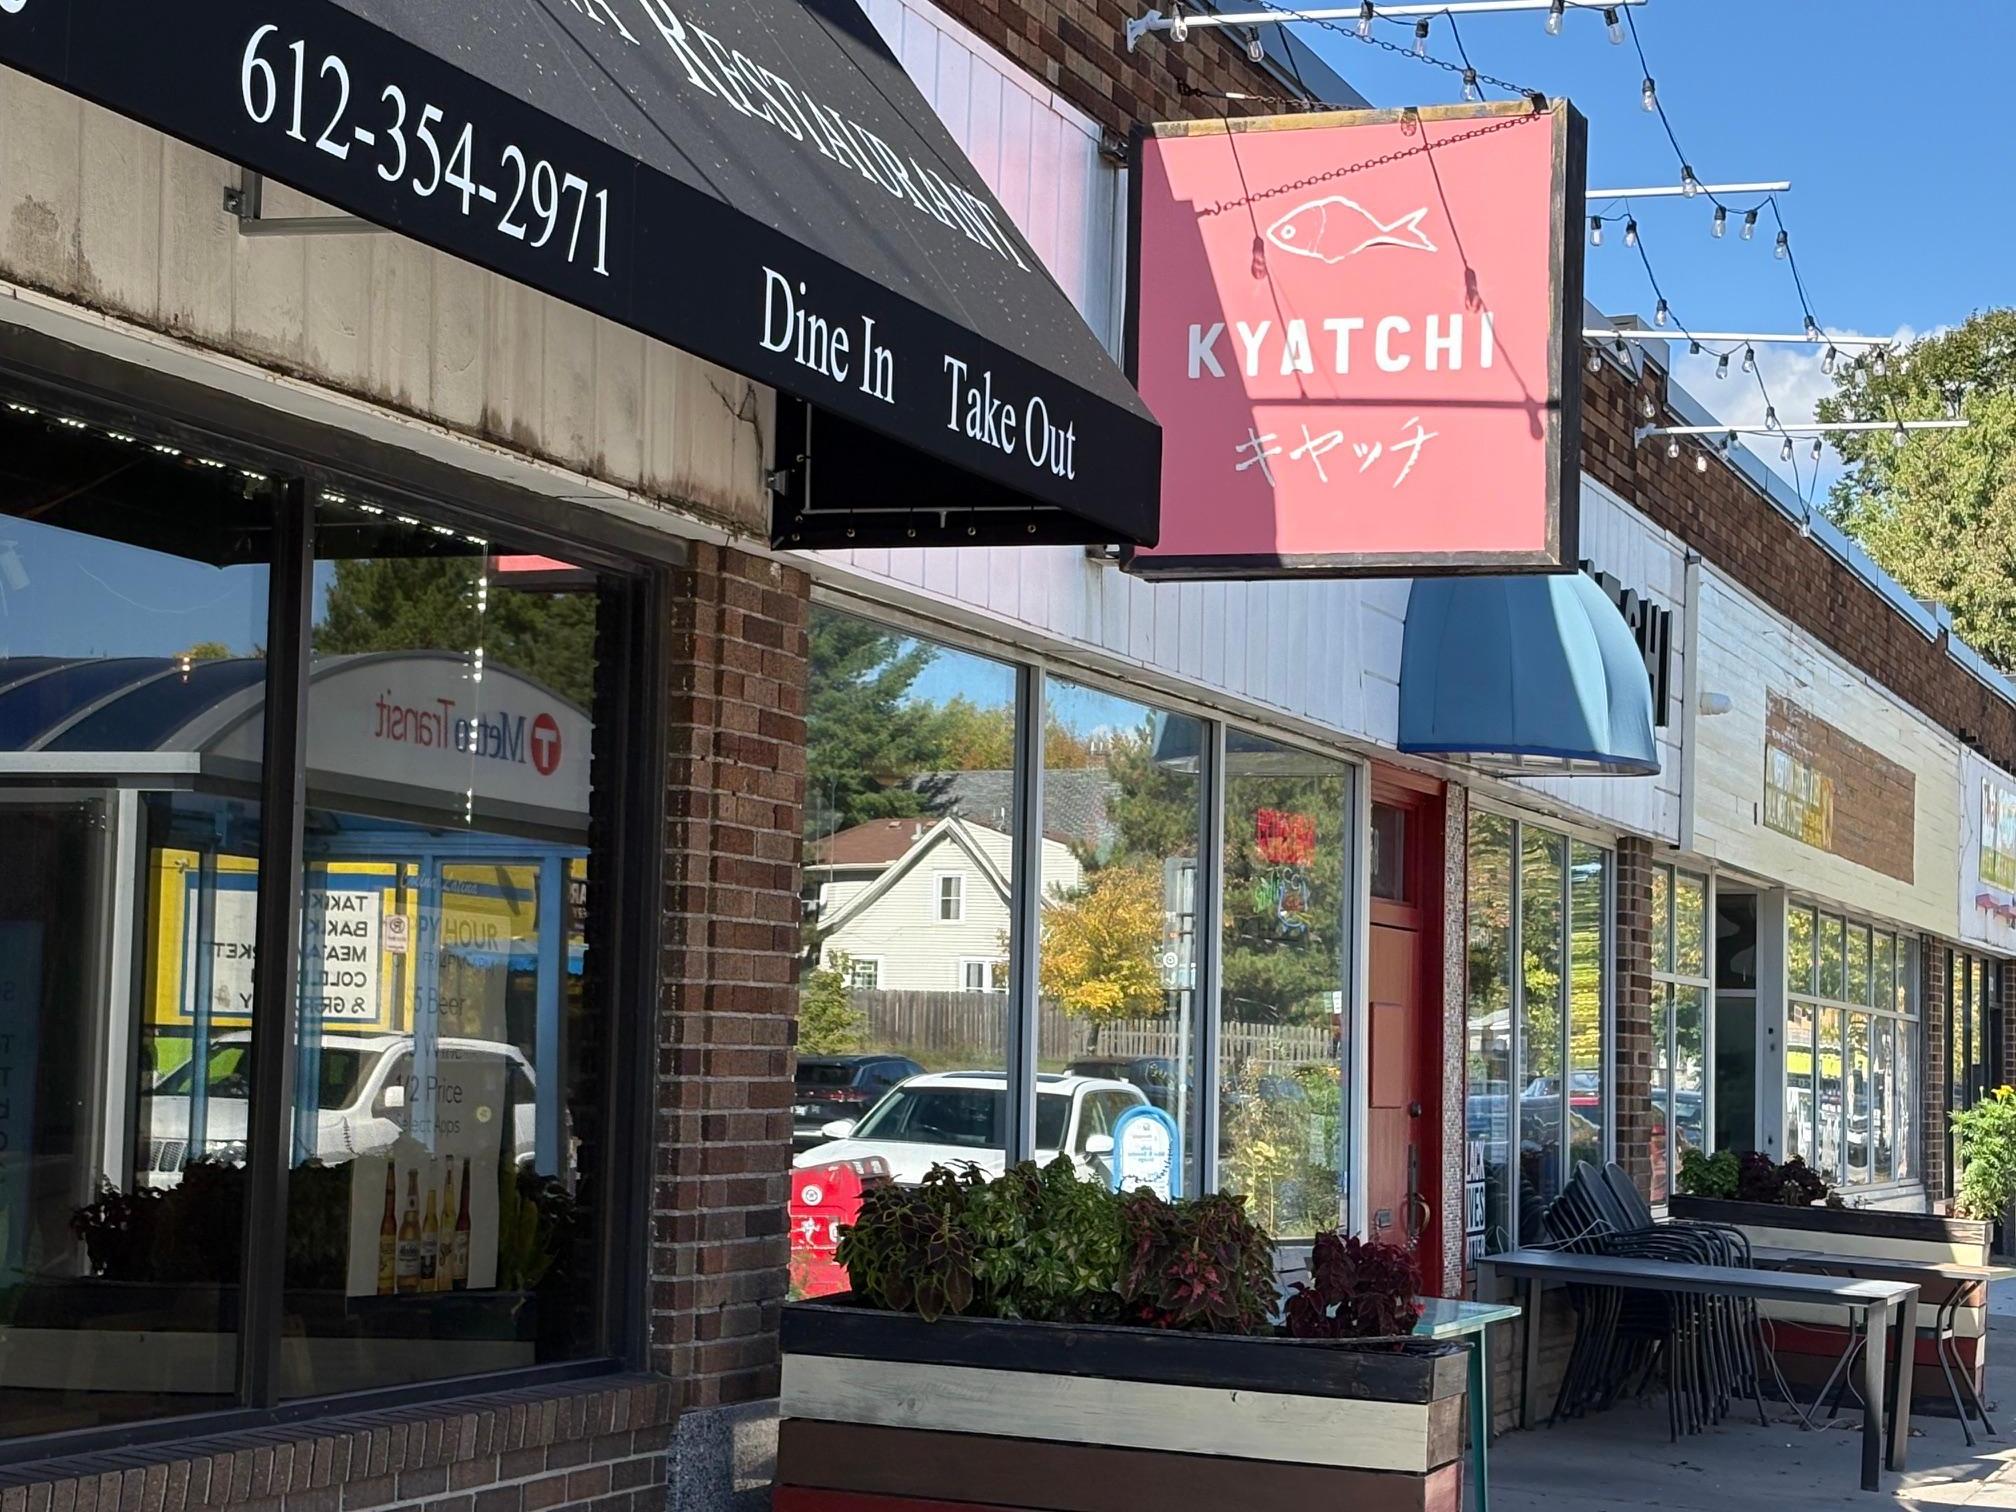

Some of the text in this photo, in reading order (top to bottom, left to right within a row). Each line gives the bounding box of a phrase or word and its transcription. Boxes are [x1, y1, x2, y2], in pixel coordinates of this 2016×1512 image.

[241, 23, 610, 277] 612-354-2971
[760, 266, 895, 404] Dine In
[1188, 312, 1494, 379] KYATCHI
[944, 354, 1076, 480] Take Out
[444, 917, 499, 952] HOUR
[427, 986, 467, 1016] Beer
[426, 1075, 463, 1104] Price
